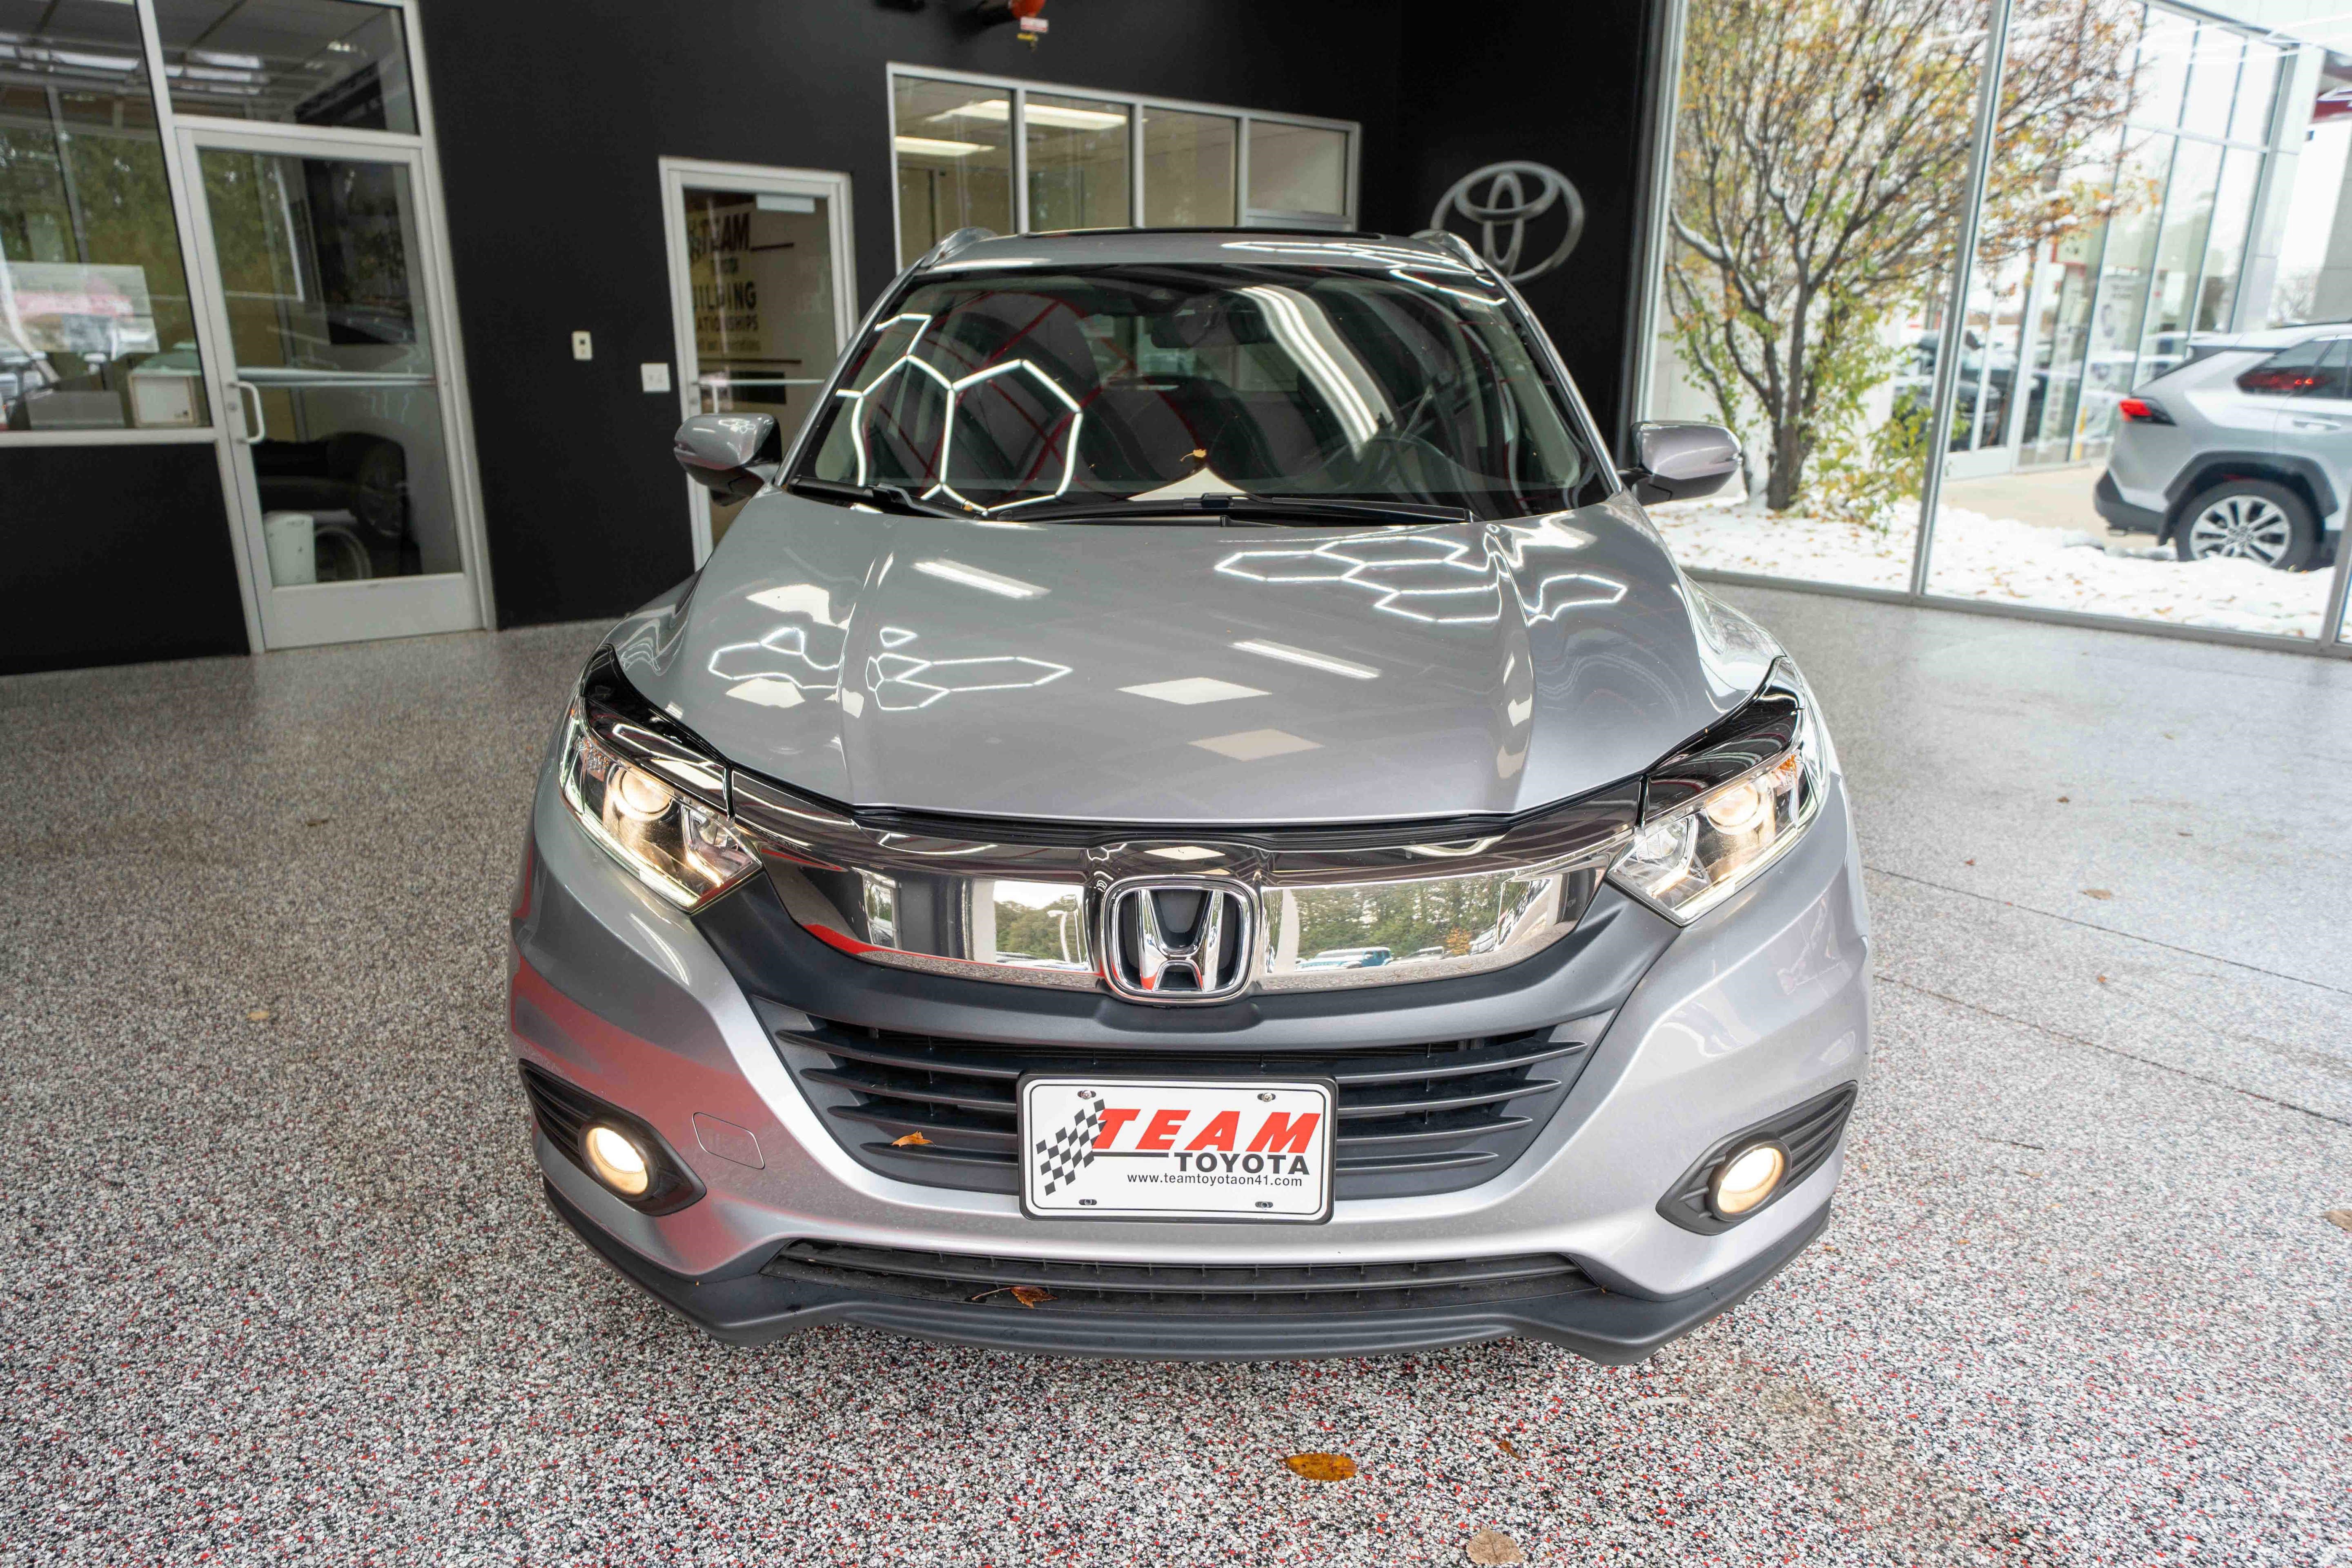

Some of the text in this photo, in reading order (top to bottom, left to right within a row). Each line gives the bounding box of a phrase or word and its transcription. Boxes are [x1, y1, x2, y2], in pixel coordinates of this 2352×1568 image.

[1091, 1108, 1321, 1154] TEAM
[1174, 1152, 1310, 1175] TOYOTA
[1127, 1173, 1302, 1187] www.teamtoyotaon41.com
